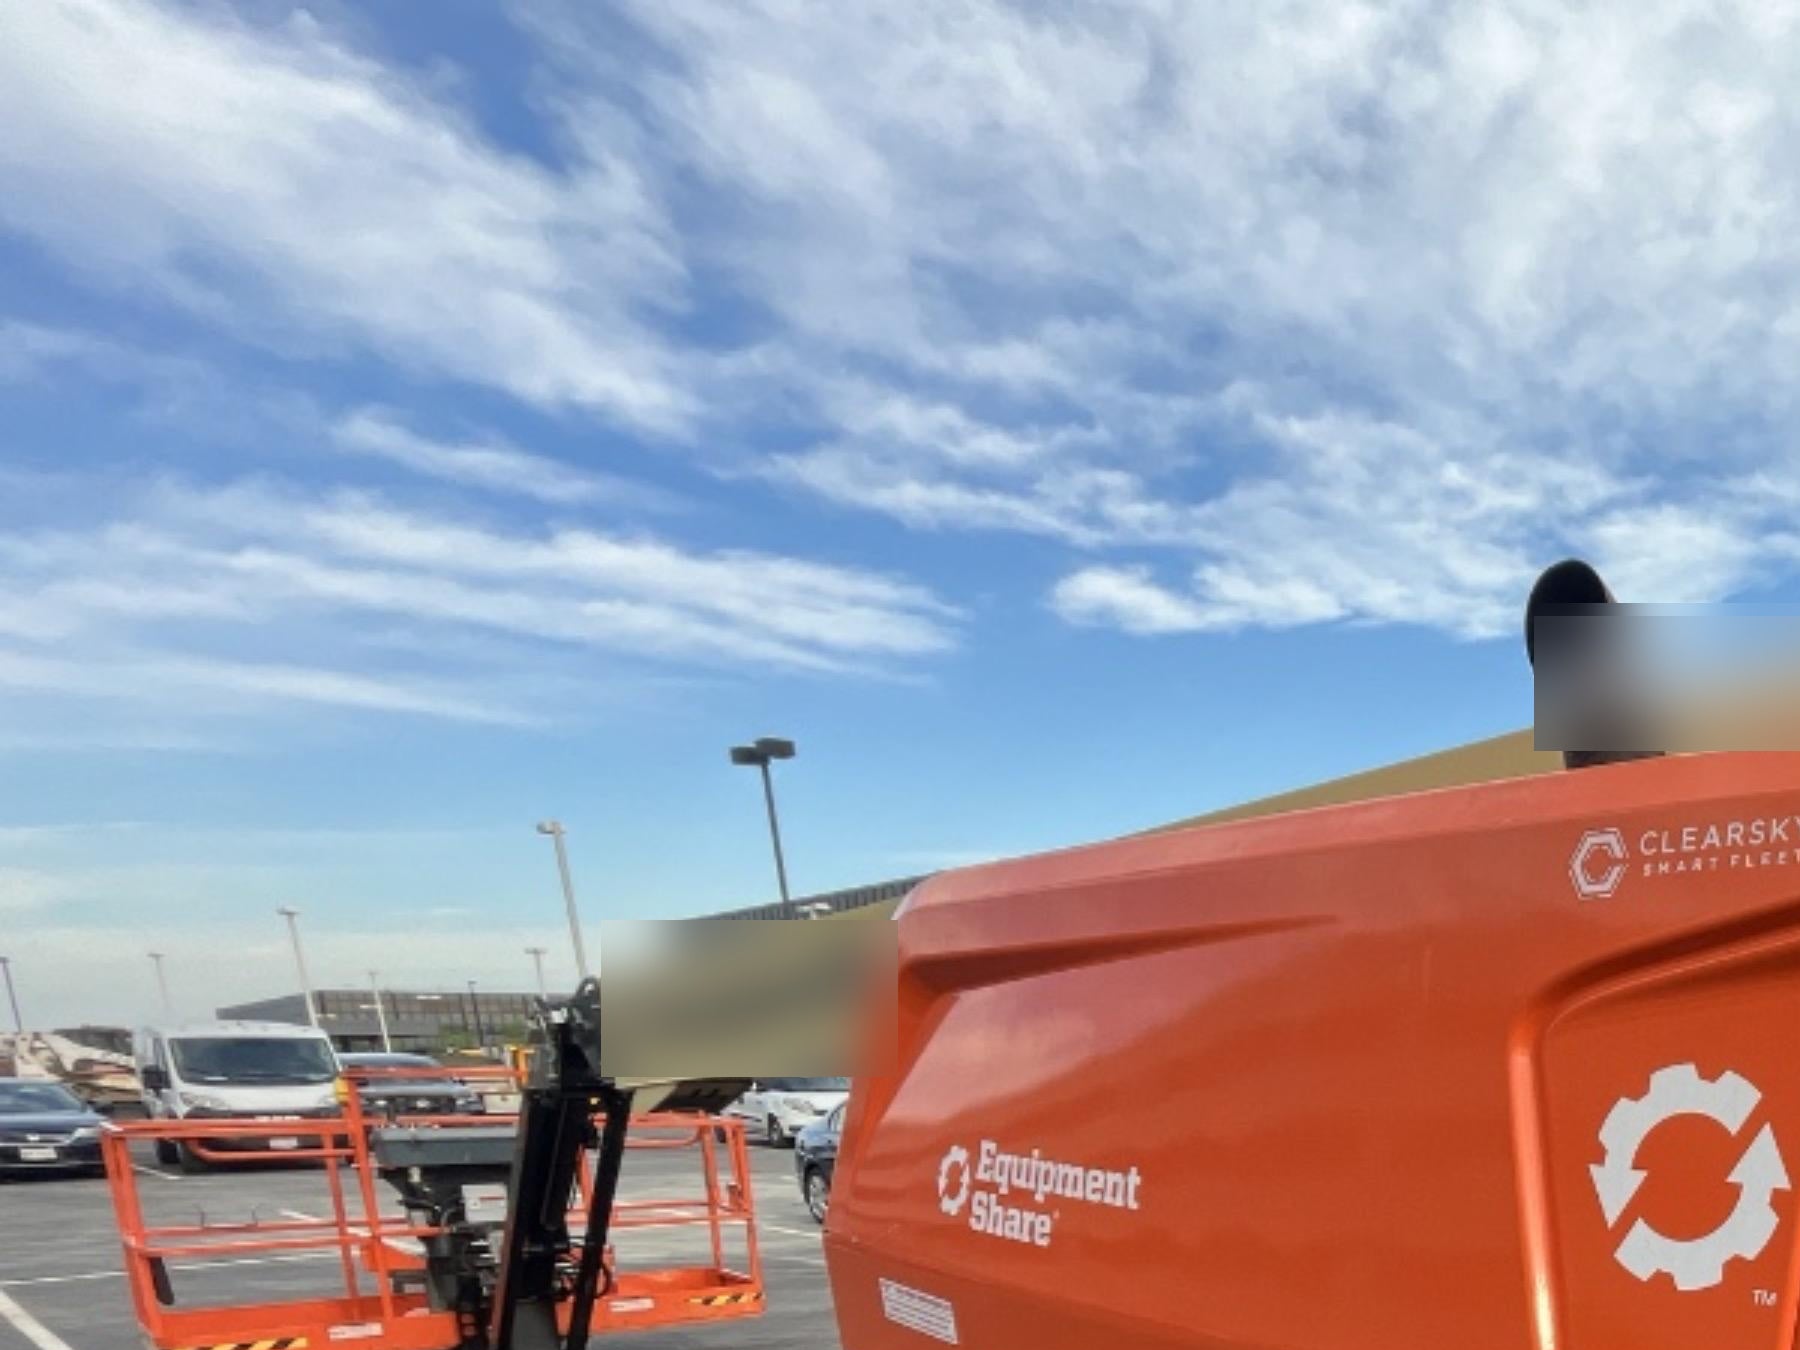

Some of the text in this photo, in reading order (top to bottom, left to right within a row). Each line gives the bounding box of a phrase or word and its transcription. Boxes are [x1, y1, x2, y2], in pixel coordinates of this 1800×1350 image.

[1643, 857, 1718, 877] SMART
[975, 1139, 1142, 1210] Equipment
[968, 1191, 1052, 1246] Share
